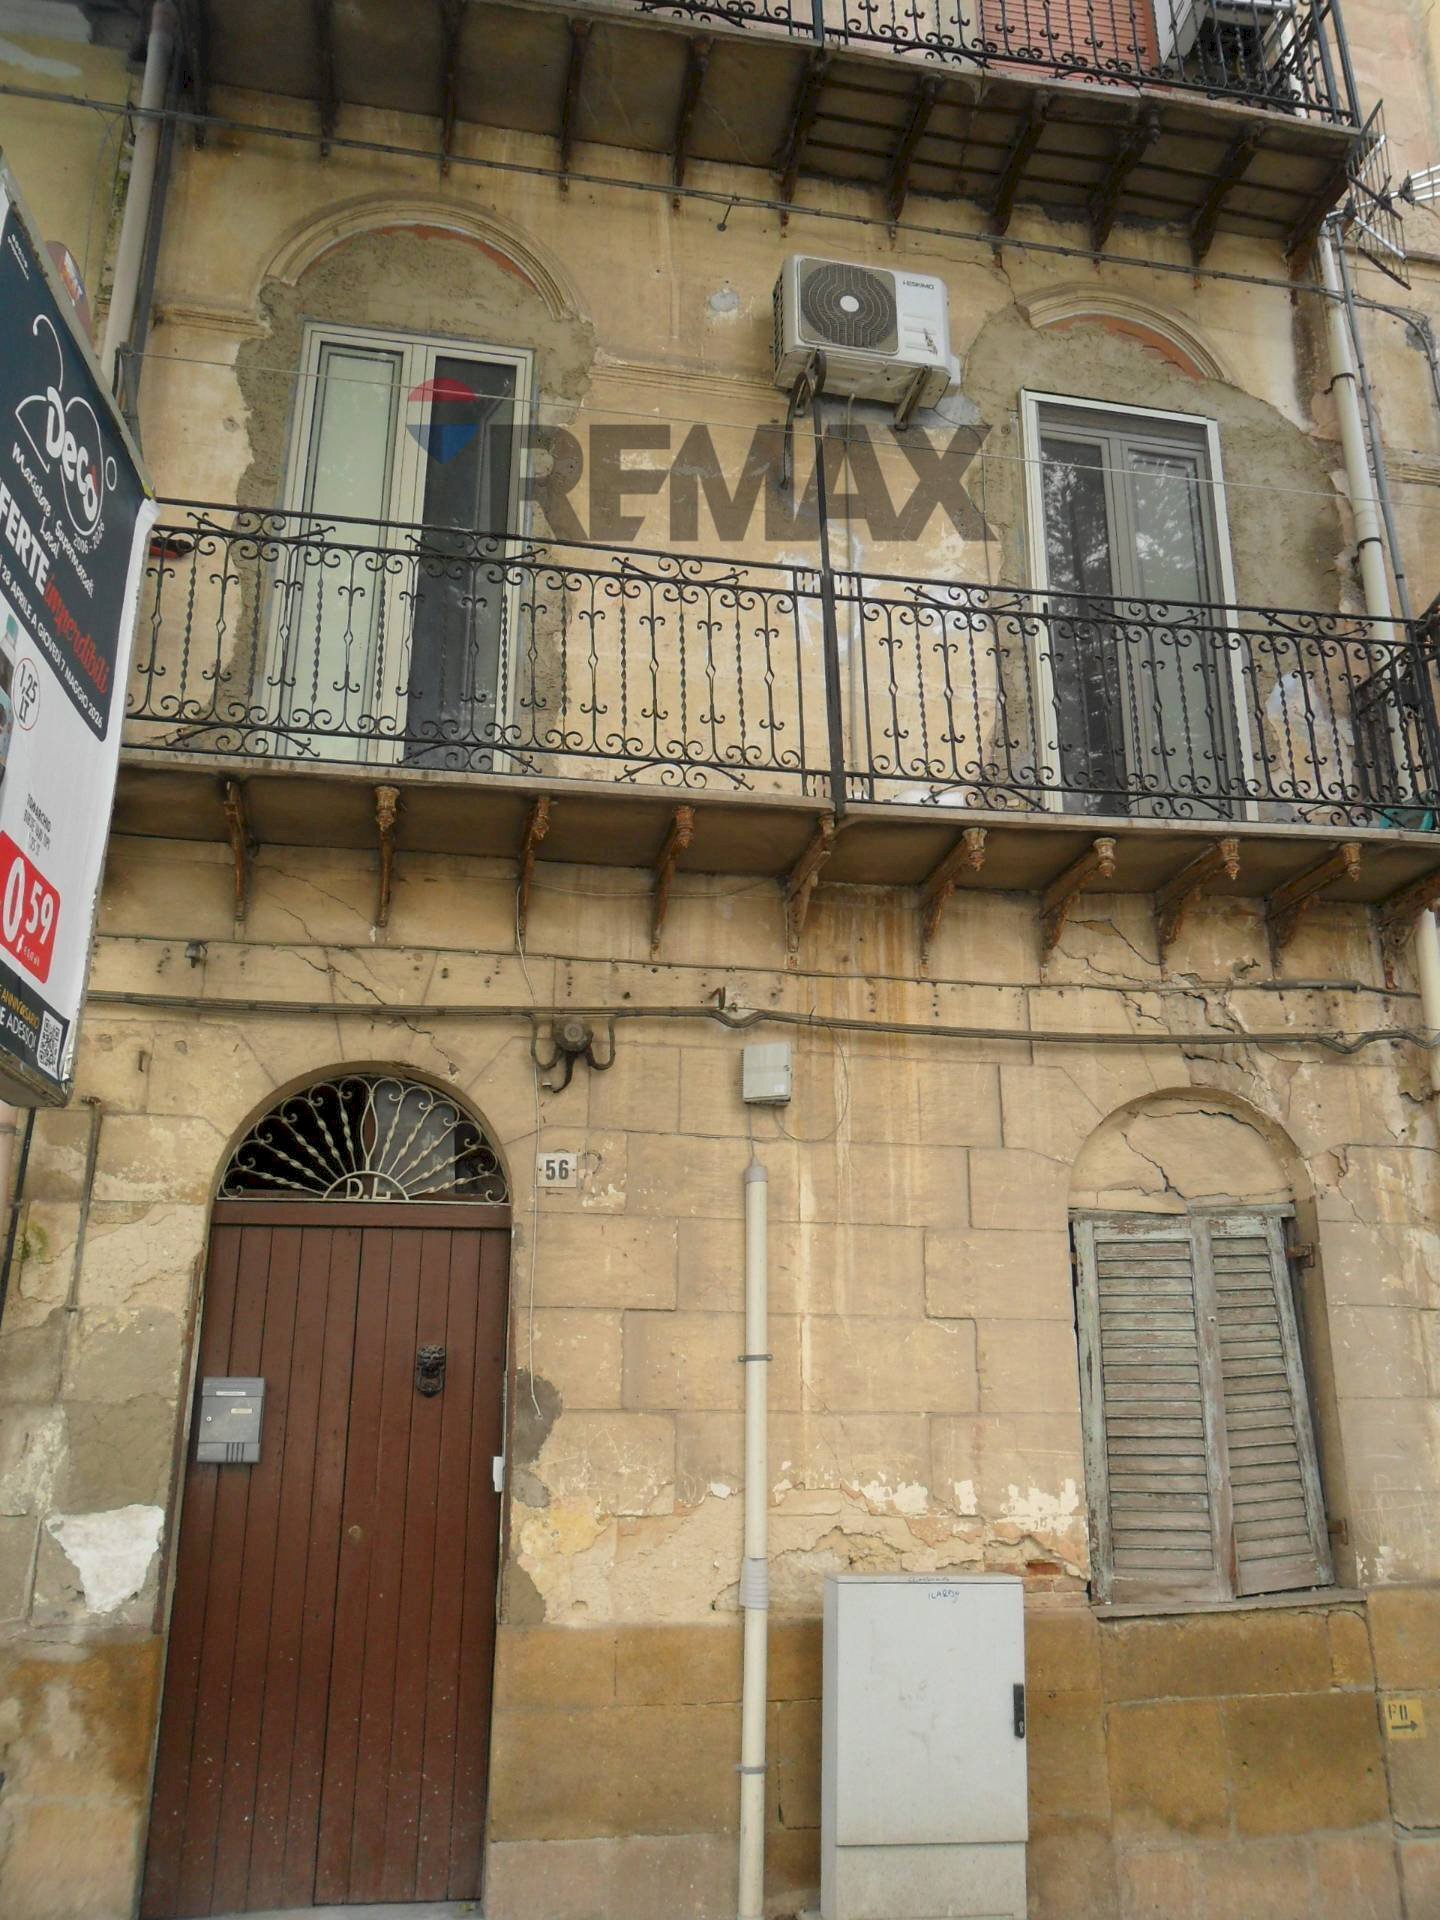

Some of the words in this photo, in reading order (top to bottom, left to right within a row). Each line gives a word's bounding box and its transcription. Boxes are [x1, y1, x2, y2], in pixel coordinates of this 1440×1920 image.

[2, 564, 11, 586] 28
[10, 580, 32, 619] APRILE
[30, 613, 37, 630] A
[60, 657, 66, 671] 7
[64, 666, 88, 709] MAGGIO
[20, 662, 37, 704] 1,25
[545, 1159, 569, 1180] 56
